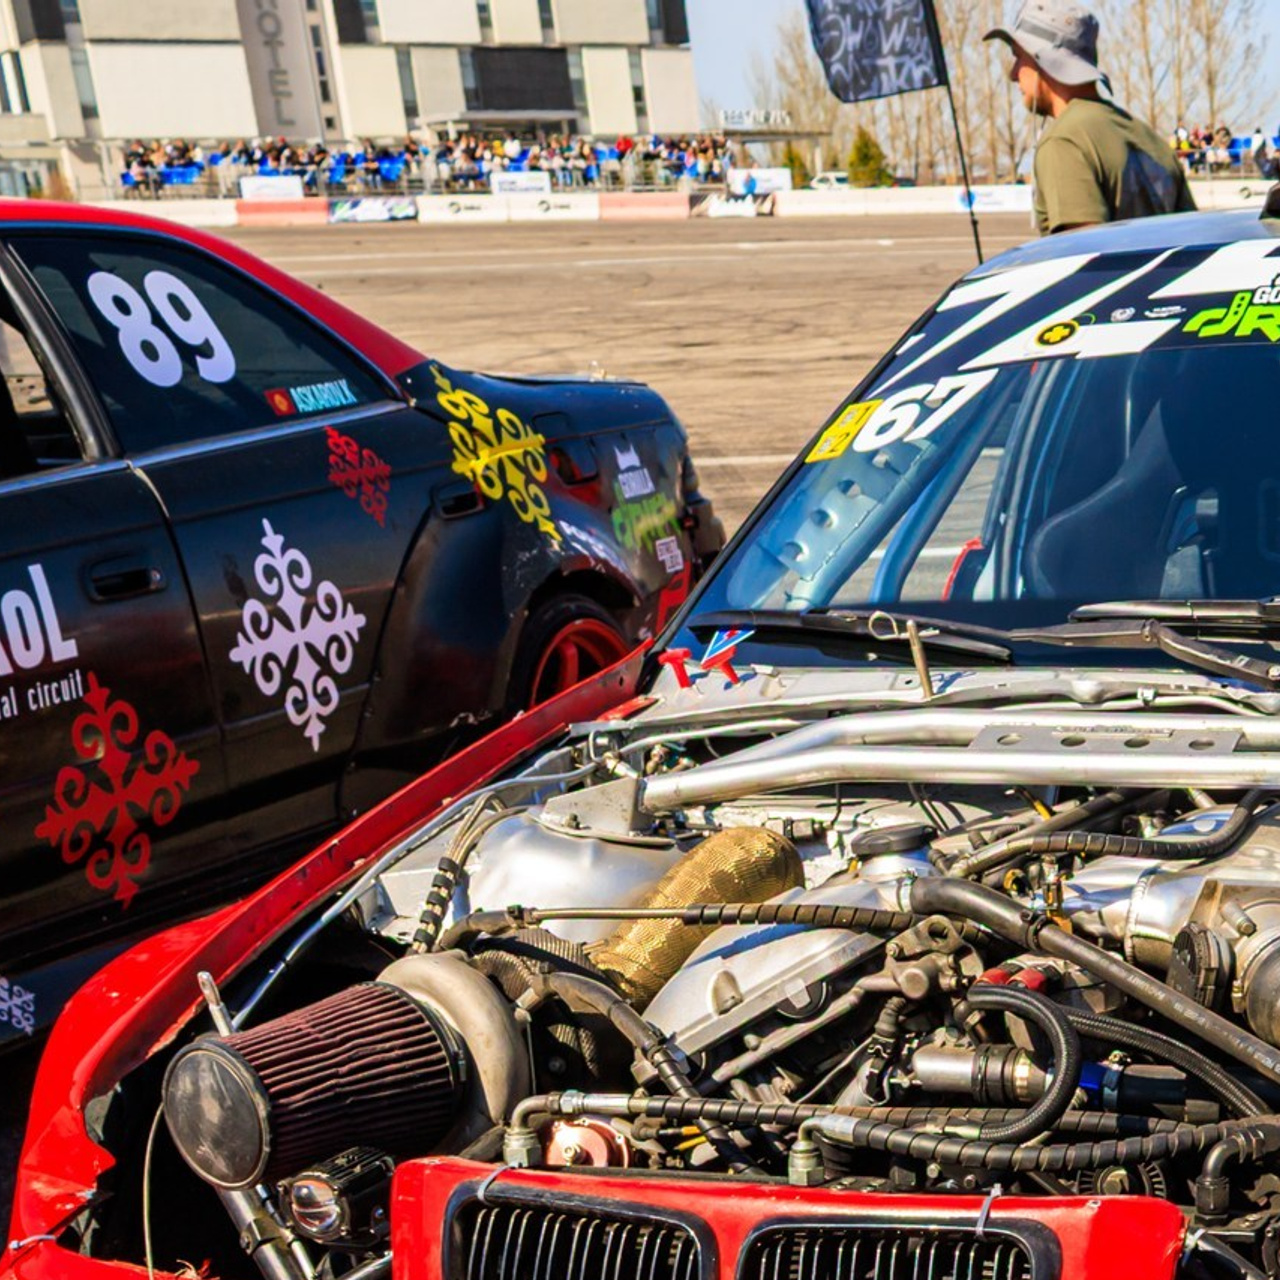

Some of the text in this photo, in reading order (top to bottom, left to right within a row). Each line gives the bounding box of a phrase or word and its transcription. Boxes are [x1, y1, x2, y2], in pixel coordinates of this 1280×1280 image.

[87, 270, 236, 388] 89
[852, 367, 999, 452] 67
[27, 668, 84, 711] circuit
